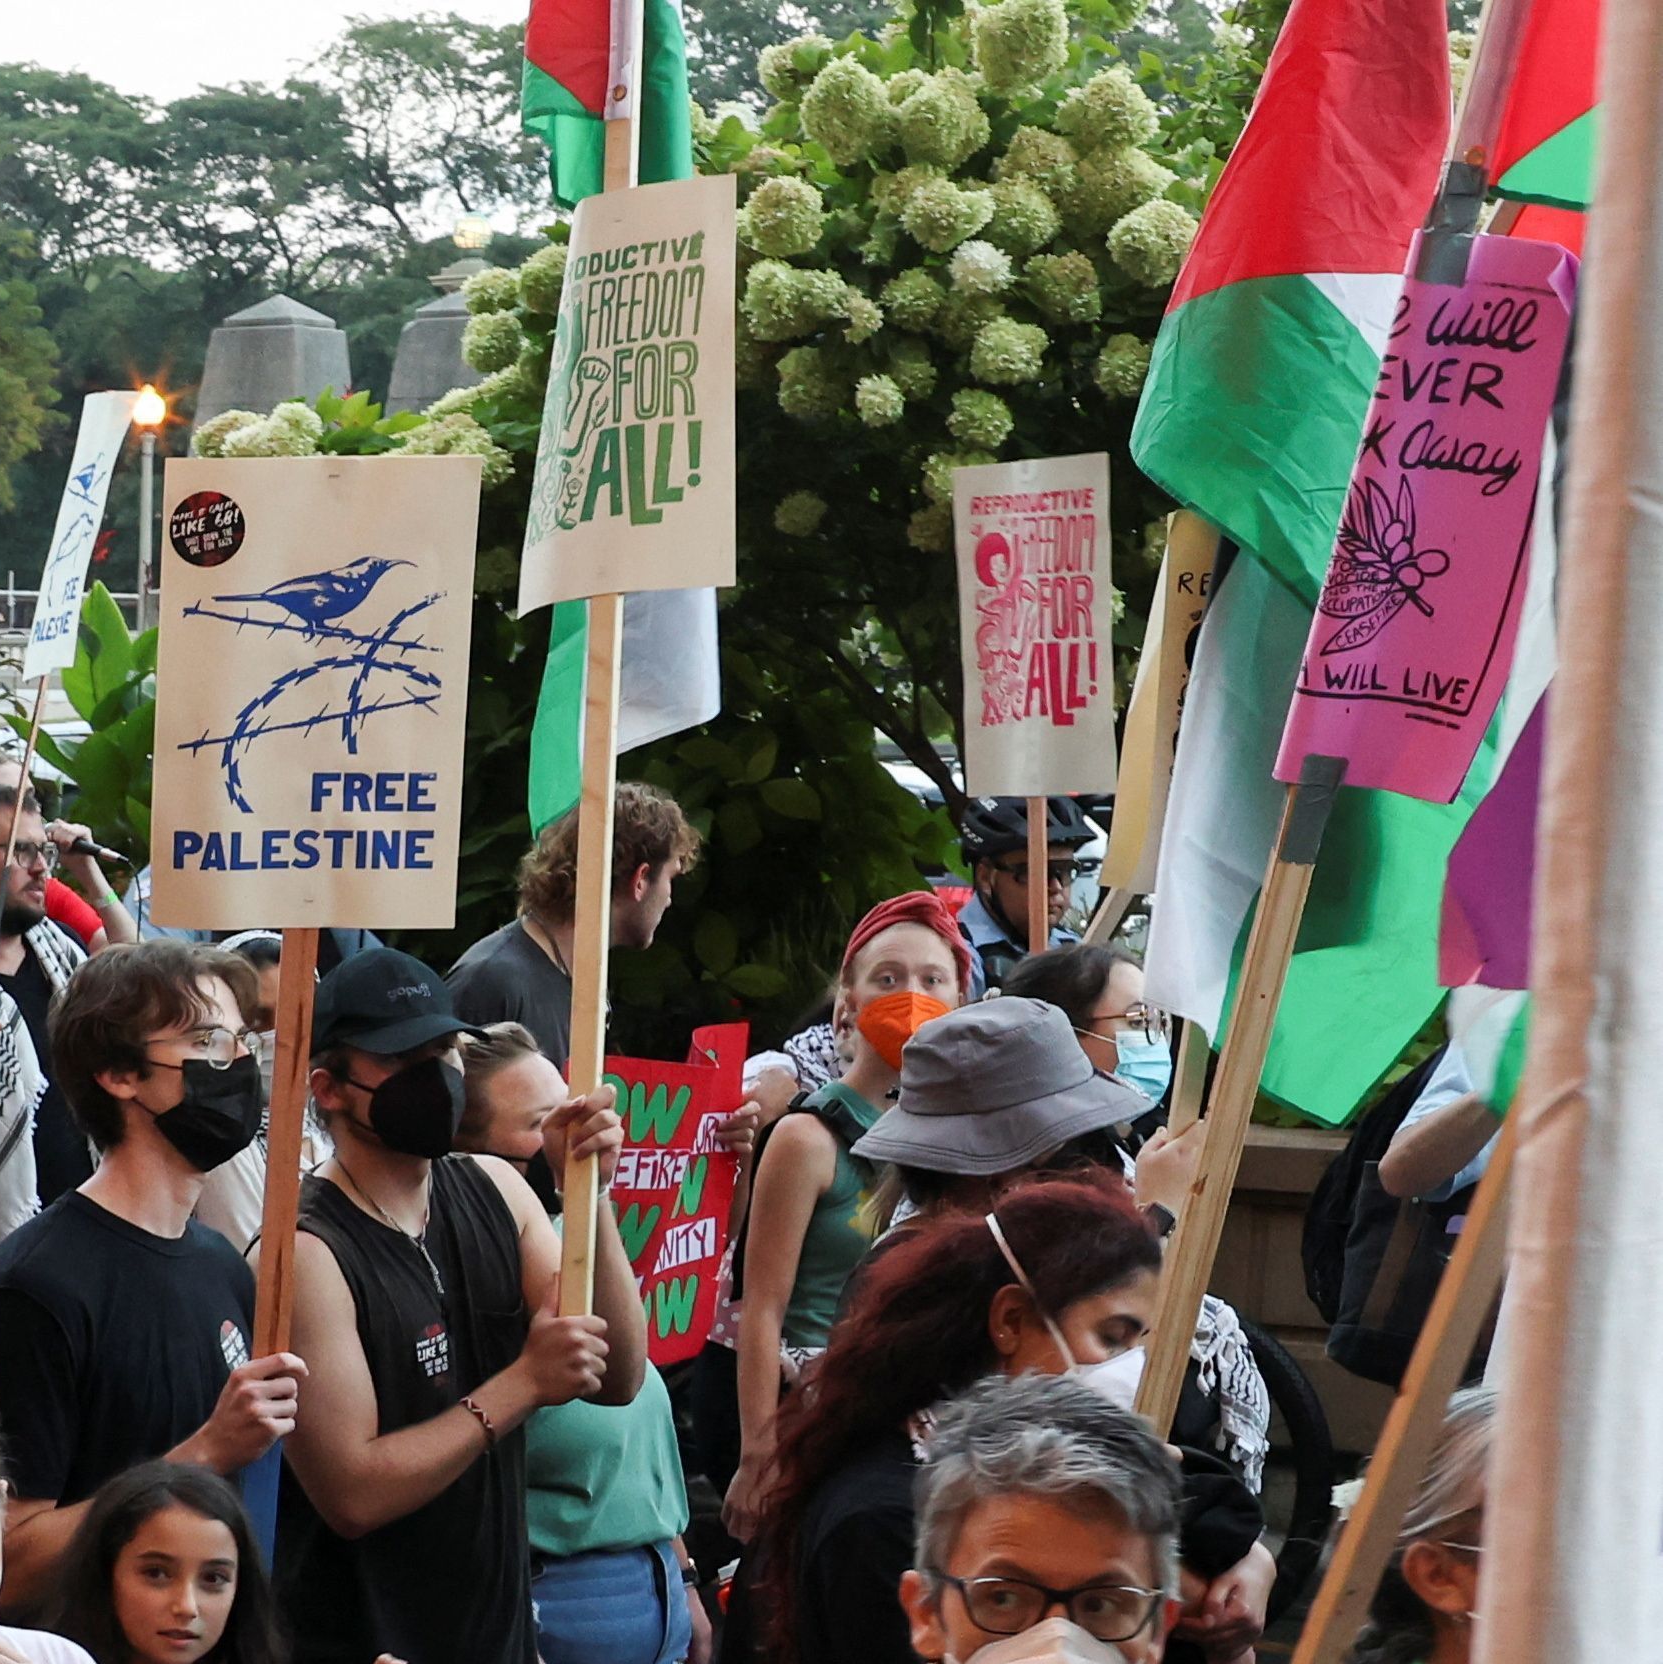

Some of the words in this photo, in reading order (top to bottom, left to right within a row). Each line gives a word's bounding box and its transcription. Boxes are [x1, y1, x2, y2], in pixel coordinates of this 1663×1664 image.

[573, 230, 706, 280] ODUCTIVE
[584, 264, 706, 352] FREEDOM
[612, 340, 700, 424] FOR
[579, 420, 703, 527] ALL!
[172, 517, 206, 538] LIKE
[1038, 575, 1094, 639] FOR
[1024, 641, 1098, 726] ALL!
[1325, 662, 1388, 693] WILL
[1402, 666, 1470, 706] LIVE
[310, 771, 438, 813] FREE
[172, 830, 436, 872] PALESTINE
